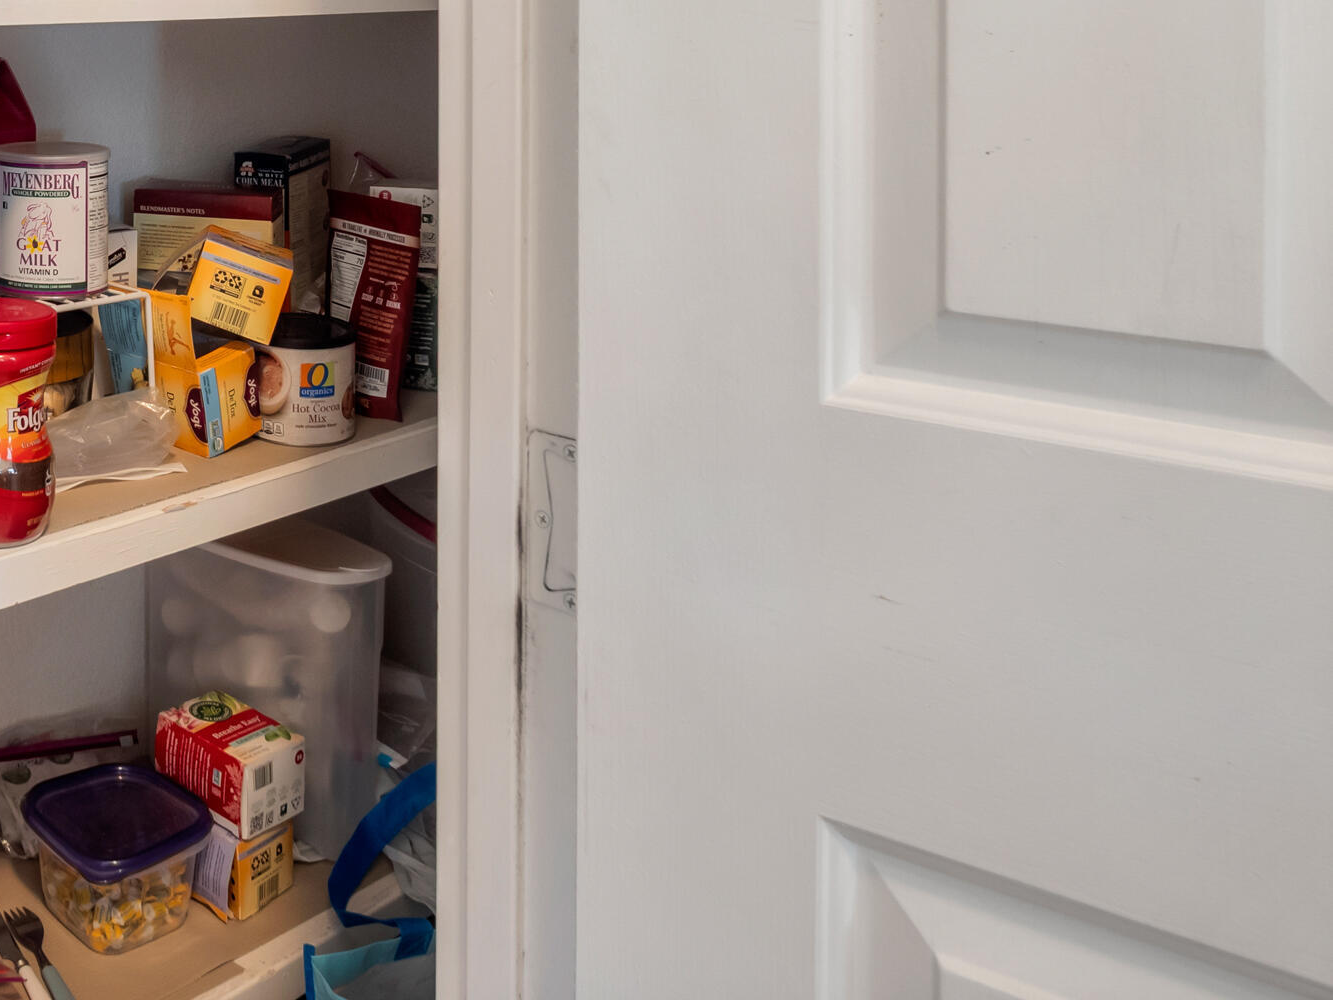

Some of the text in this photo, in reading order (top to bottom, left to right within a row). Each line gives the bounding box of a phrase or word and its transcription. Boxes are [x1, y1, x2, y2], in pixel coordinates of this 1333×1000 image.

[3, 170, 80, 200] MEYENBERG
[236, 176, 285, 187] CORN MEAL
[34, 190, 69, 198] POWDERED
[140, 205, 206, 215] BLENDMASTER'S NOTES
[19, 253, 57, 267] MILK
[19, 267, 50, 276] VITAMIN
[301, 388, 333, 397] organics
[292, 402, 340, 413] Hot Cocoa
[190, 398, 203, 429] yogi
[308, 413, 327, 423] Mix
[211, 723, 243, 740] Breathe
